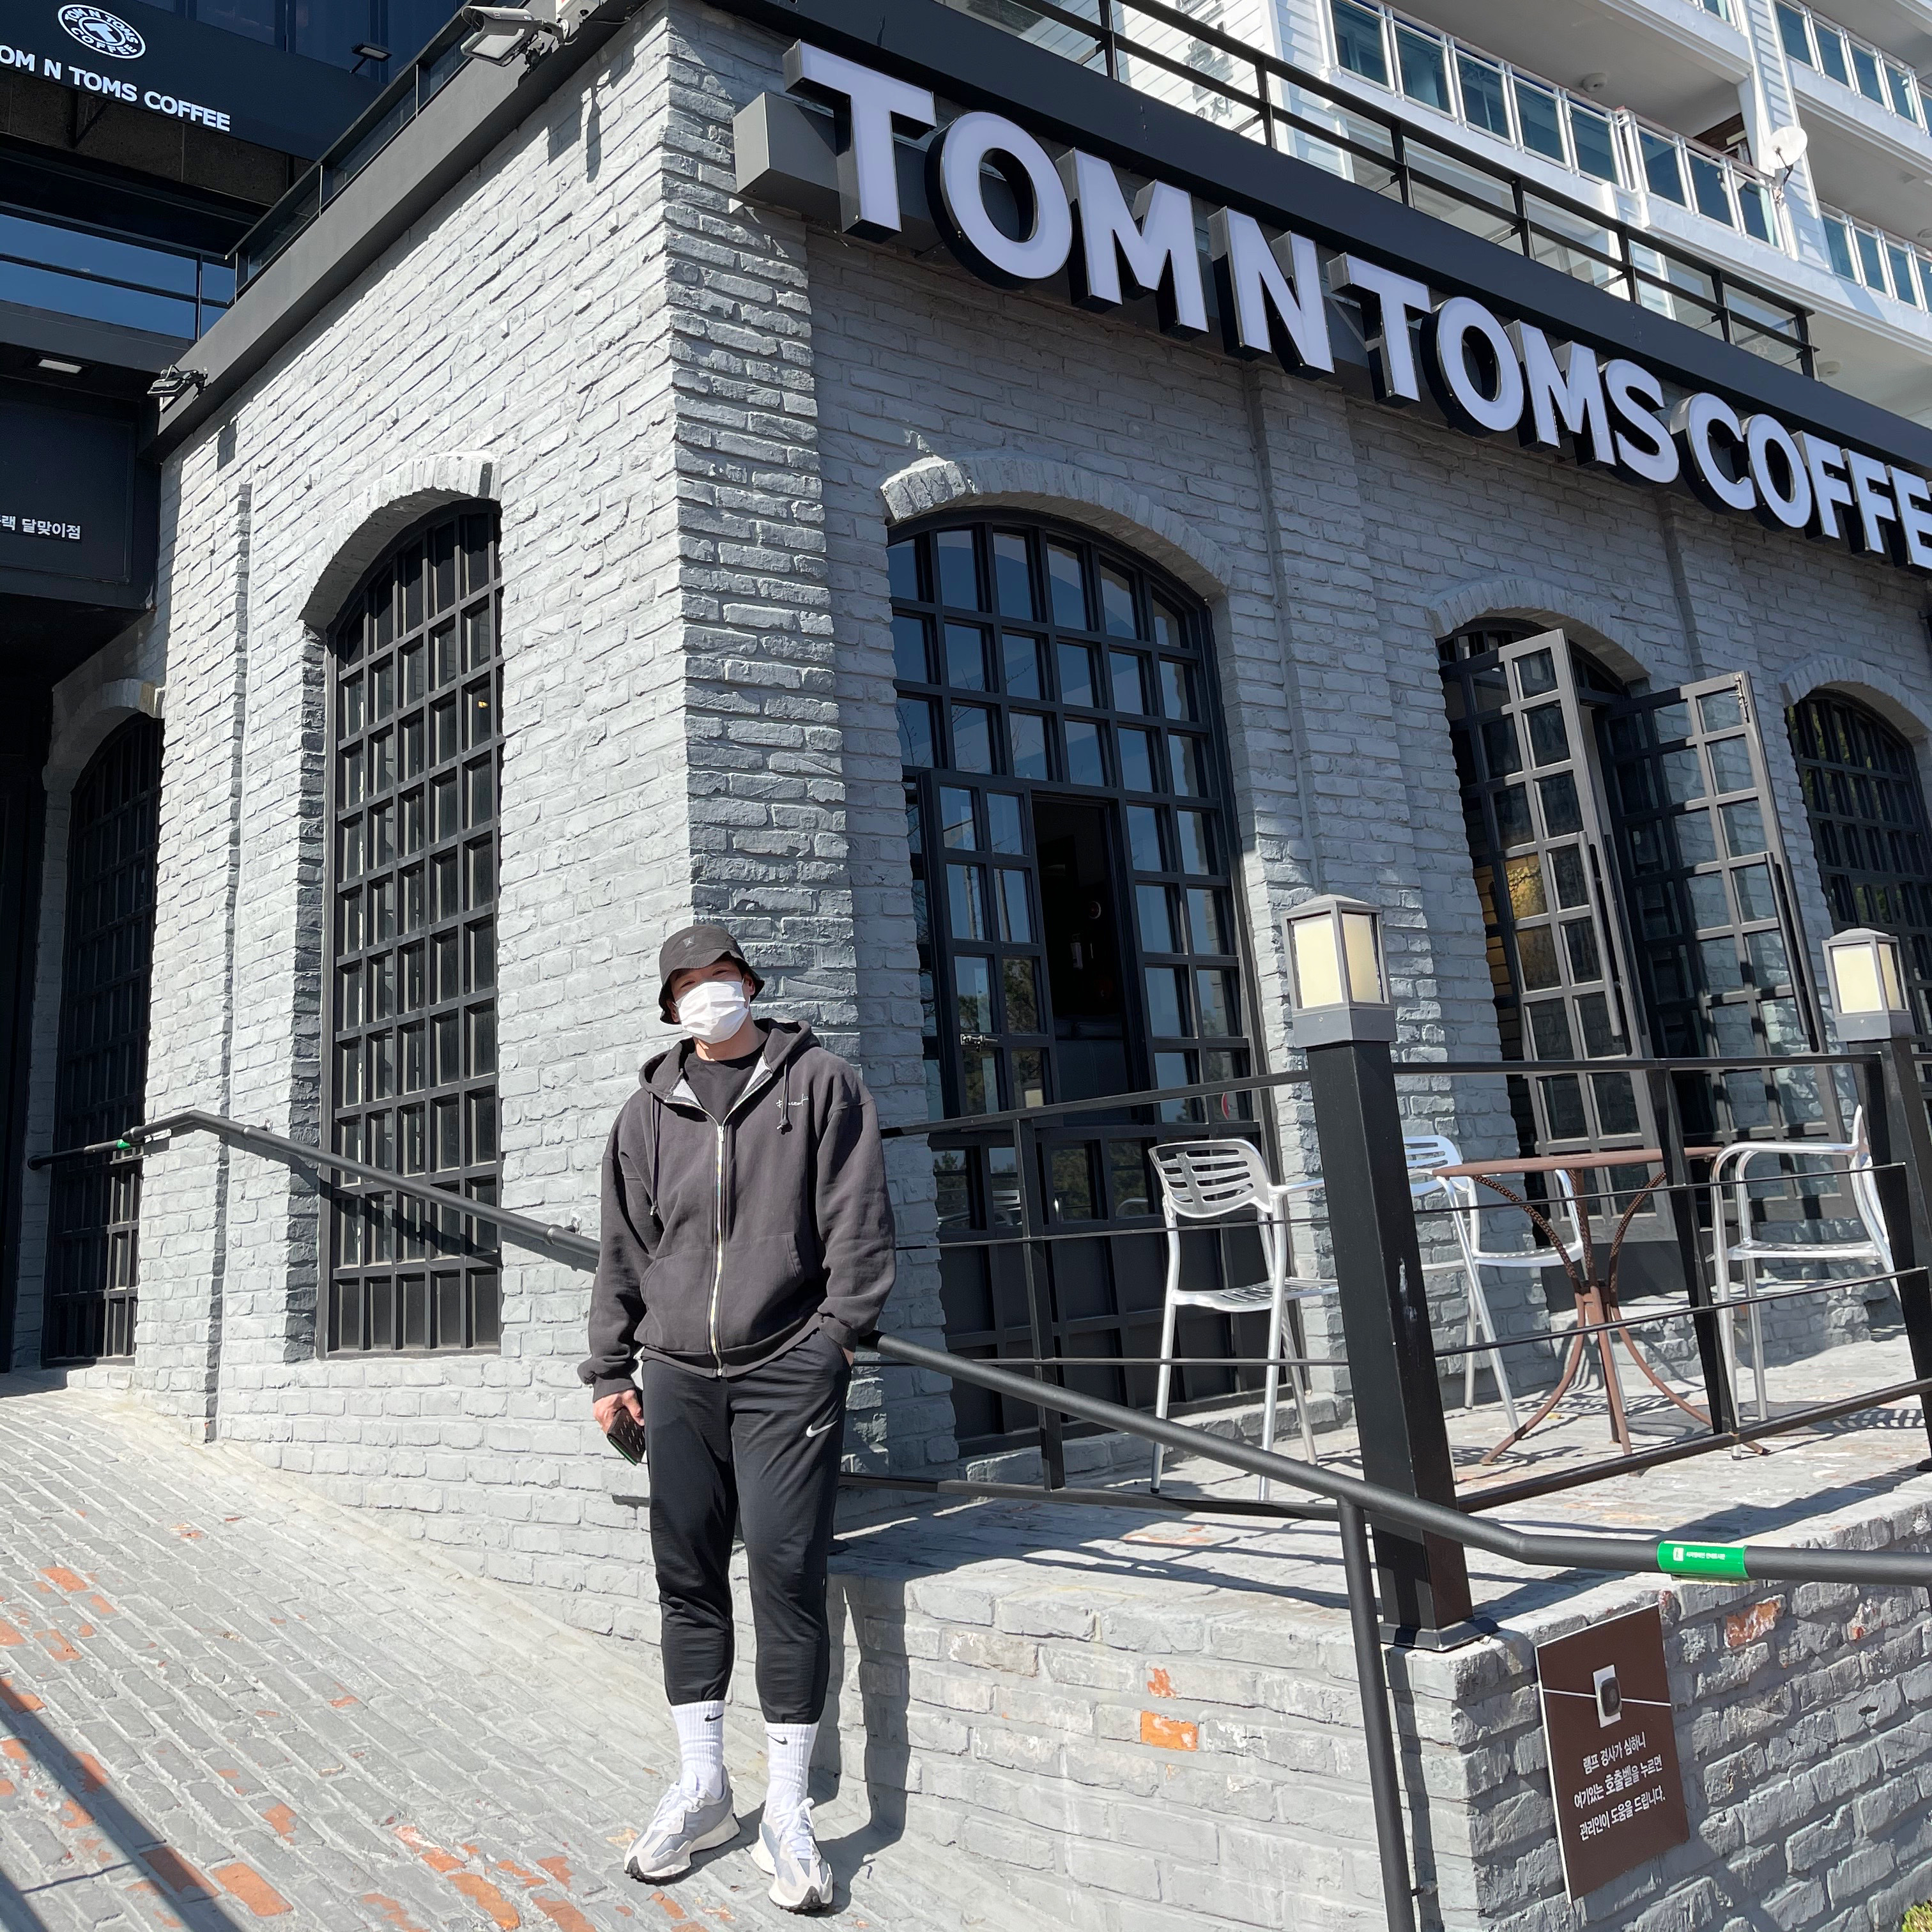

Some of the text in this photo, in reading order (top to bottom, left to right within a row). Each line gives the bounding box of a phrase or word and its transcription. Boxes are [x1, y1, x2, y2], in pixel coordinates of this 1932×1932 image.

[65, 8, 139, 43] TOM N TOMS
[70, 27, 137, 54] COFFEE
[44, 59, 61, 80] N
[68, 66, 138, 102] TOMS
[144, 91, 231, 132] COFFEE
[792, 38, 1209, 335] TOM
[1220, 204, 1335, 376] N
[1337, 252, 1680, 484] TOMS
[1679, 391, 1932, 570] COFFE
[0, 515, 81, 540] 랙 달맞이점
[1583, 1731, 1646, 1775] 램프 경사가 심하니
[1574, 1754, 1663, 1809] 여기있는 호출벨을 누르면
[1579, 1784, 1666, 1841] 관리인이 도움을 드립니다.
